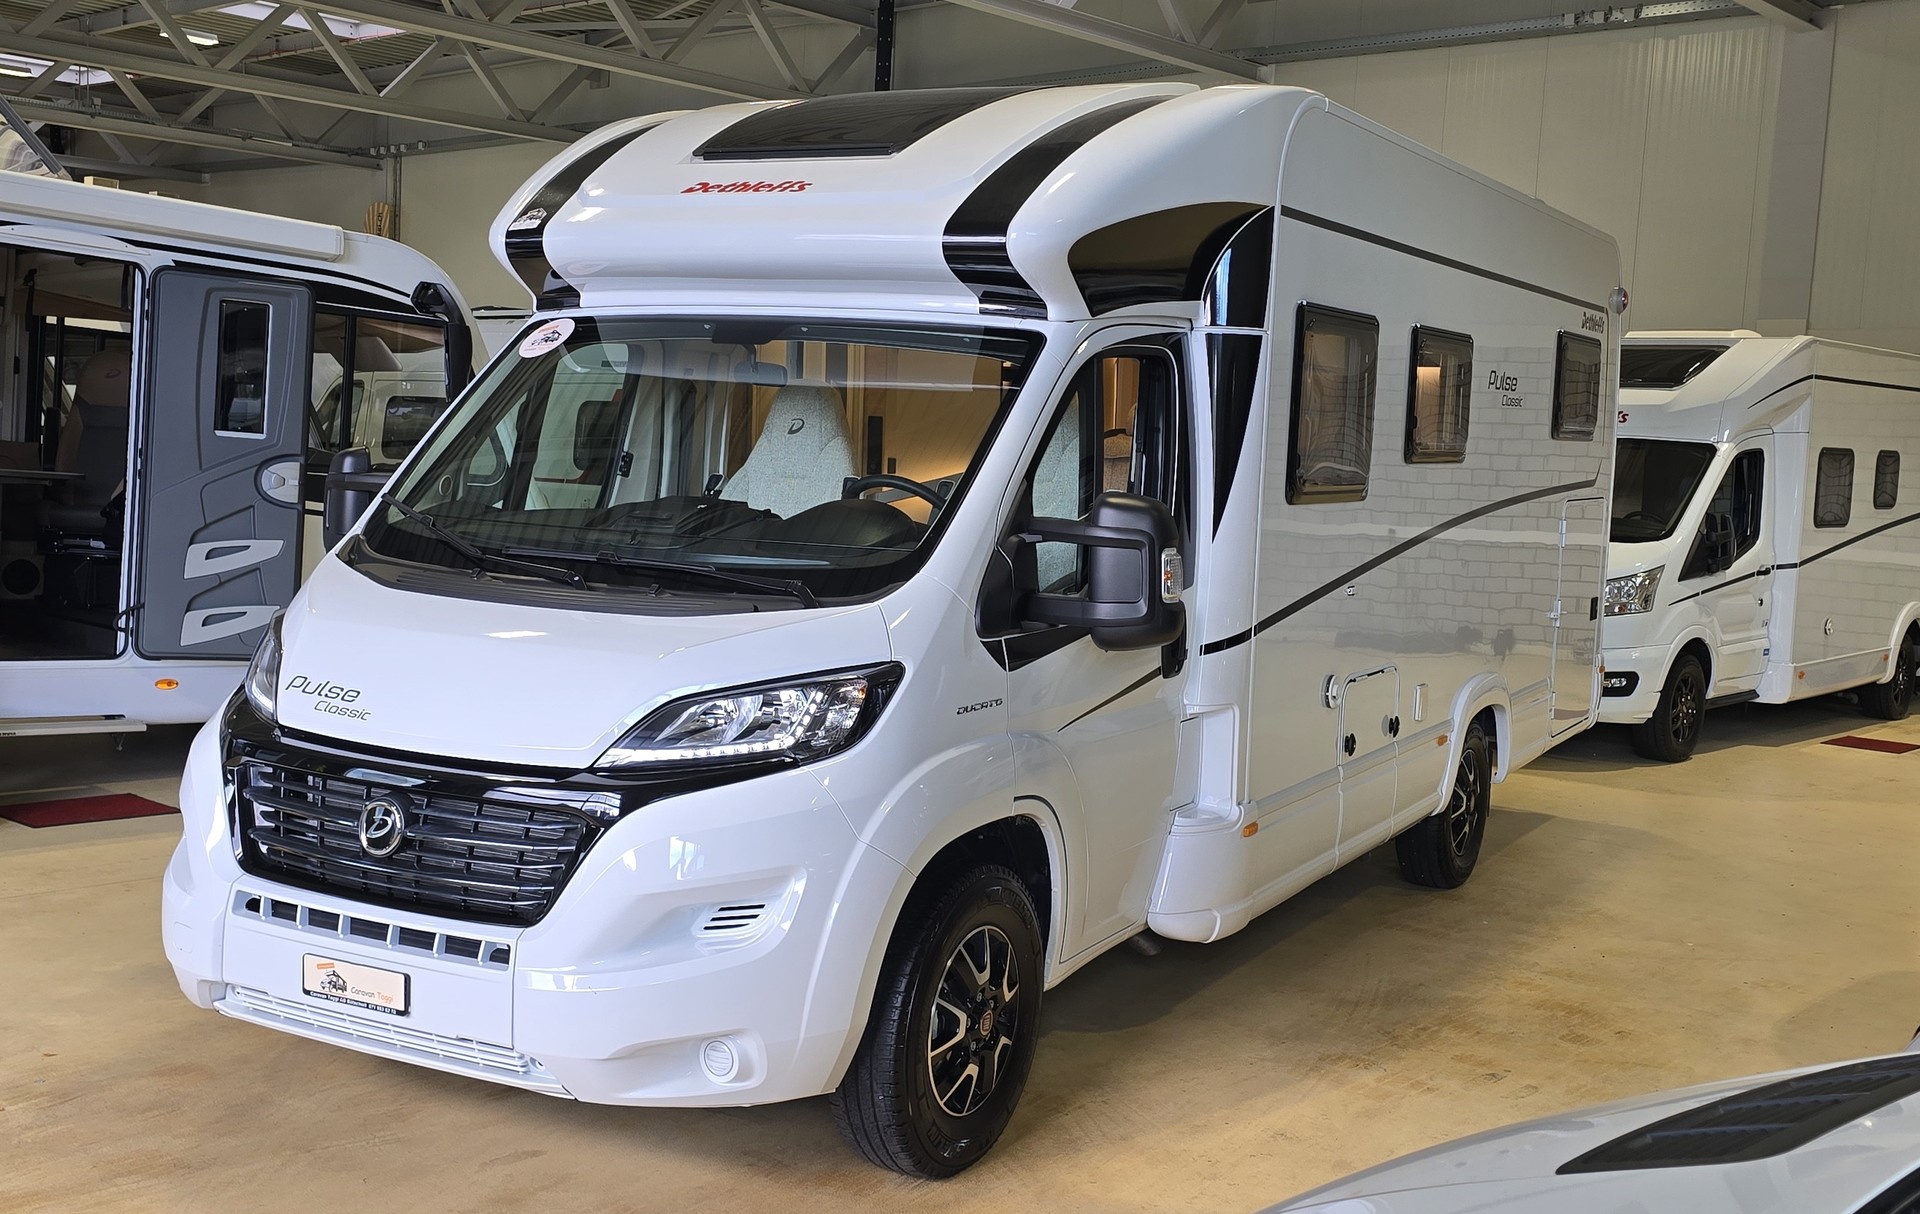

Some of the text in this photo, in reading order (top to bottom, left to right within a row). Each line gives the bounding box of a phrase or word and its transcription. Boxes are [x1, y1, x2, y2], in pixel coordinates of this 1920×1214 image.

[680, 181, 812, 193] Dethleffs
[1488, 370, 1518, 391] Pulse
[1502, 394, 1523, 407] Classic
[285, 675, 361, 703] Pulse
[314, 700, 371, 721] Classic
[957, 698, 1003, 715] DUCATO
[351, 986, 375, 999] Caravan
